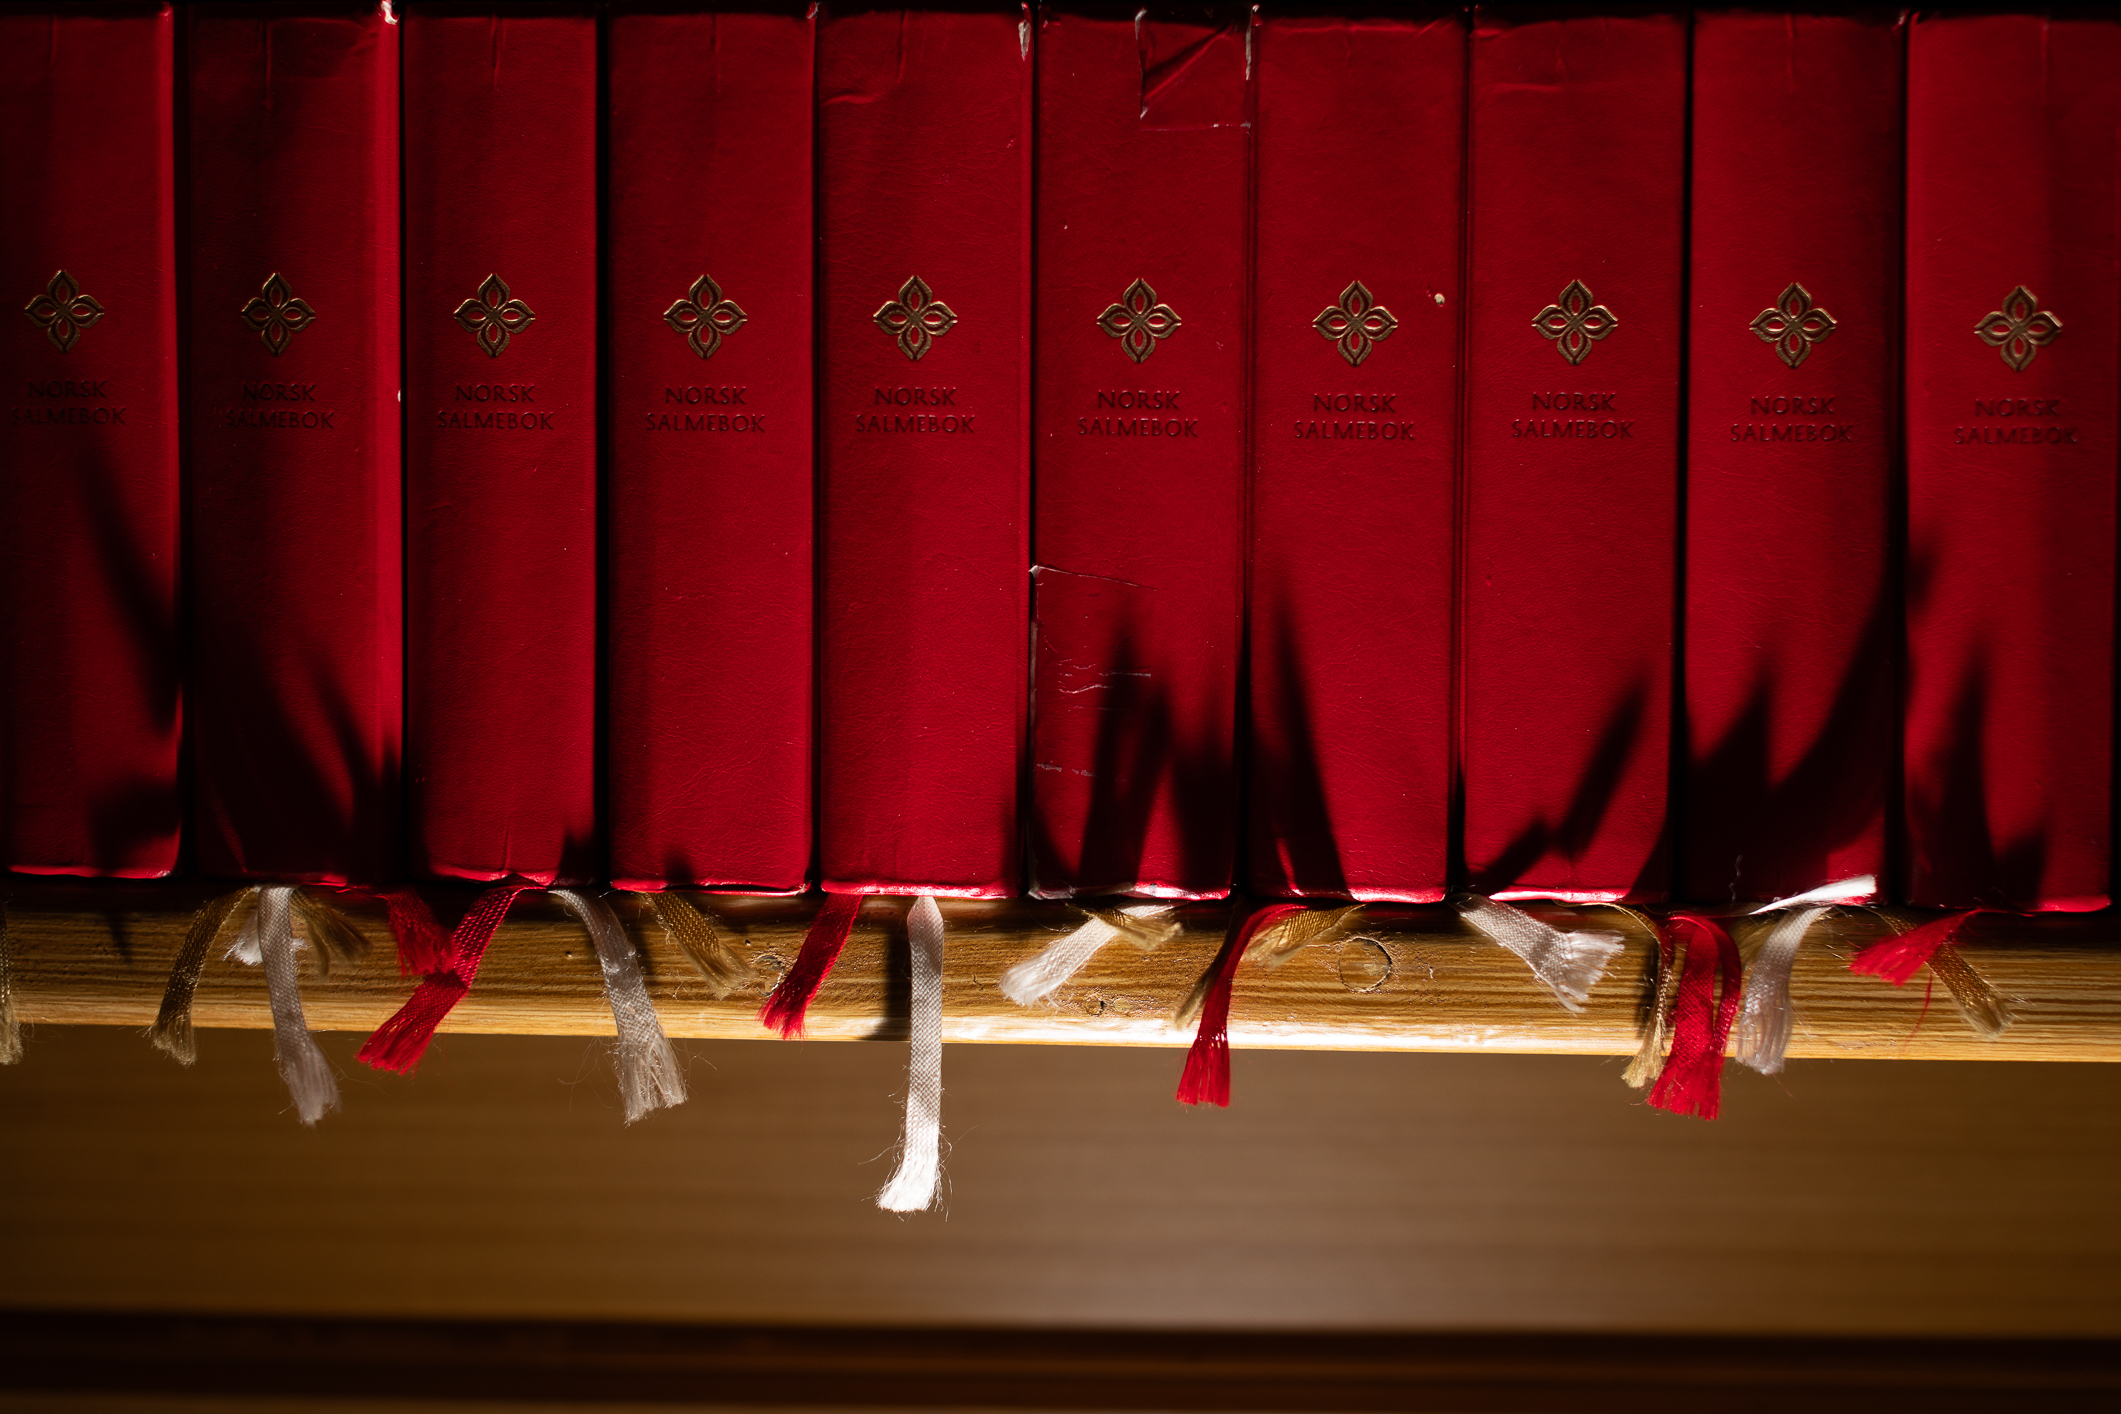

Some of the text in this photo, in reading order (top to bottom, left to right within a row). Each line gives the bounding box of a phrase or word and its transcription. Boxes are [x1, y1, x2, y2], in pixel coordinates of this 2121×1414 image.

[28, 381, 106, 399] NORSK
[242, 382, 316, 401] NORSK
[456, 384, 534, 403] NORSK
[664, 387, 747, 406] NORSK
[874, 386, 957, 406] NORSK
[1099, 389, 1180, 409] NORSK
[1313, 392, 1396, 412] NORSK
[1533, 391, 1616, 411] NORSK
[1751, 395, 1834, 415] NORSK
[1975, 399, 2060, 418] NORSK
[12, 407, 126, 427] SALMEBOK
[226, 409, 334, 430] SALMEBOK
[438, 410, 554, 430] SALMEBOK
[646, 413, 765, 433] SALMEBOK
[856, 414, 975, 434] SALMEBOK
[1078, 417, 1198, 438] SALMEBOK
[1294, 419, 1413, 440] SALMEBOK
[1511, 419, 1634, 440] SALMEBOK
[1731, 423, 1853, 443] SALMEBOK
[1954, 426, 2078, 446] SALMEBOK
